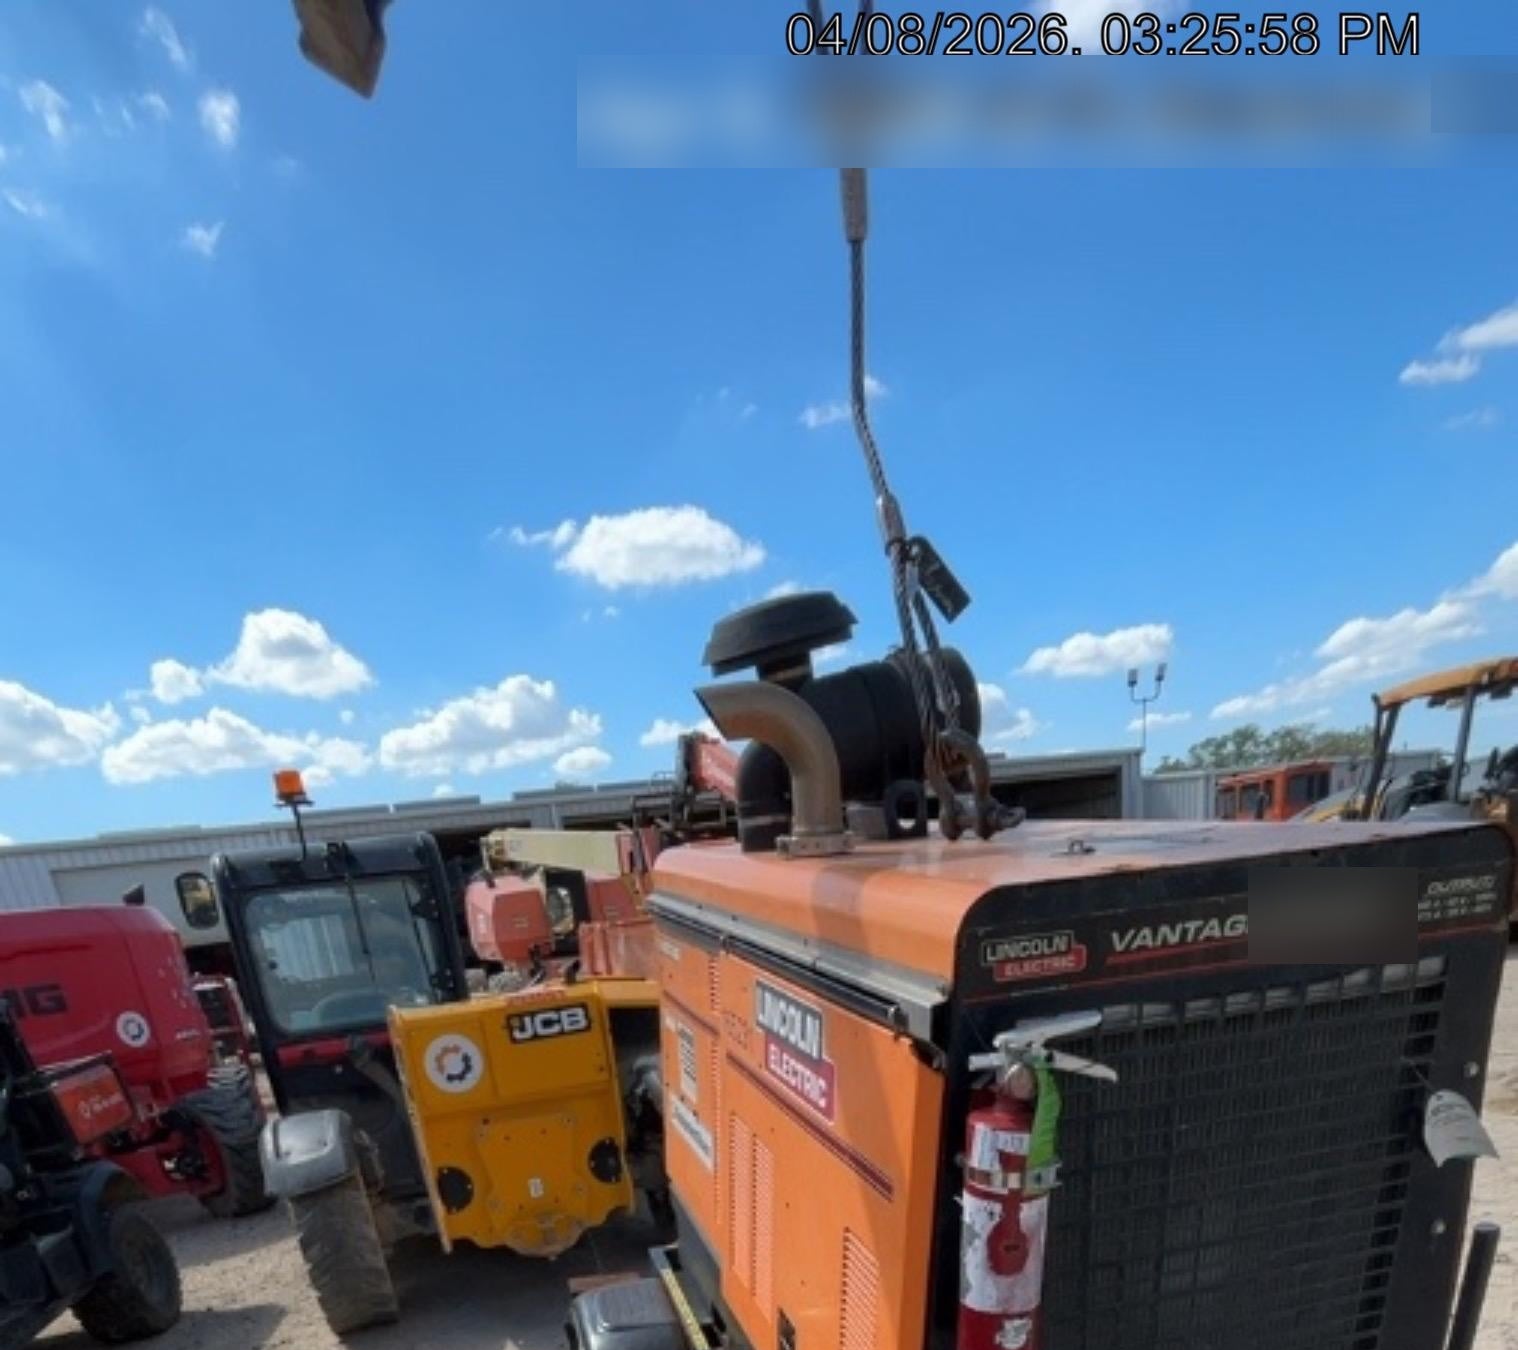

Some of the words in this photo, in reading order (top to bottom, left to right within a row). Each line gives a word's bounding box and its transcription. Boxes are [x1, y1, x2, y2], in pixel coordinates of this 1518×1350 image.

[986, 934, 1067, 963] LINCOLN
[1110, 914, 1249, 952] VANTAG
[1003, 956, 1076, 977] ELECTRIC
[511, 1007, 588, 1040] JCB
[758, 990, 822, 1061] LINCOLN
[768, 1042, 828, 1110] ELECTRIC
